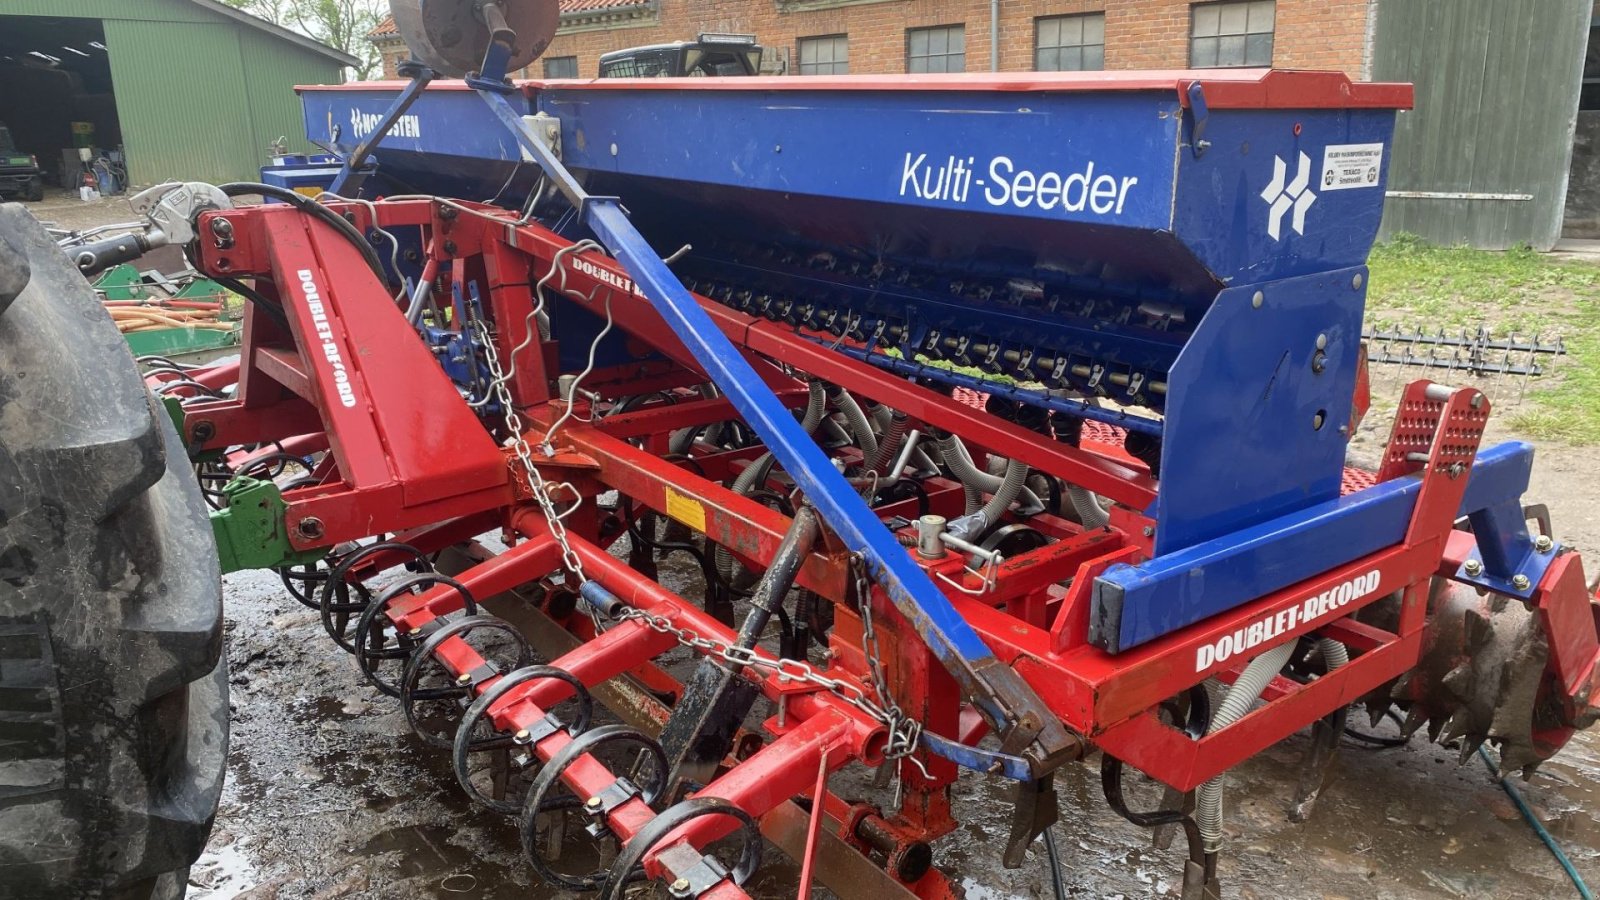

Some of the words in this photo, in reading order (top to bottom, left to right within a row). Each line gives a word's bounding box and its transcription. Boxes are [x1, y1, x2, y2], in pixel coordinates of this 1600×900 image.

[362, 113, 420, 138] NOSTEN
[899, 152, 1138, 214] Kulti-Seeder
[297, 269, 356, 408] DOUBLET-RECORD
[1195, 569, 1381, 673] DOUBLET-RECORD
